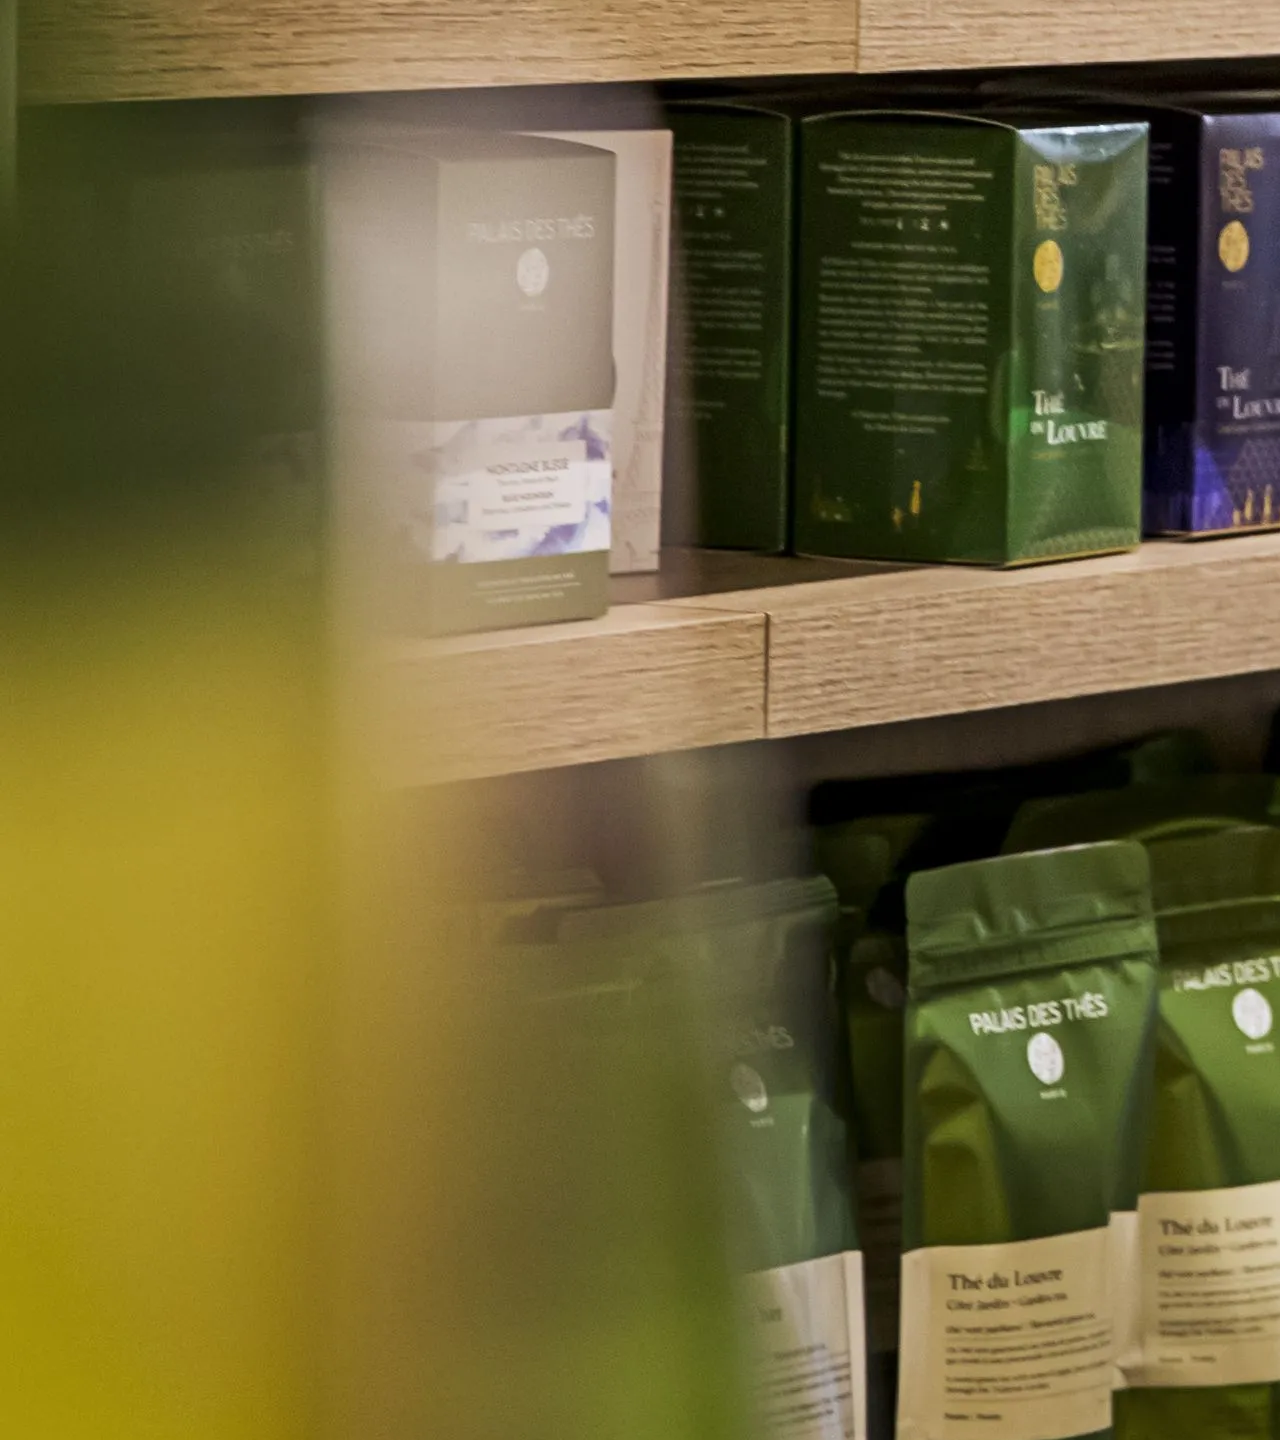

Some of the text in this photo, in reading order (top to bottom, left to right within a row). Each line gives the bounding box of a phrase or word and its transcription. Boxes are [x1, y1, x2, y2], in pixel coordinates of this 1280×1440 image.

[969, 1006, 1028, 1036] PALAIS
[1027, 1001, 1063, 1028] DES
[947, 1272, 984, 1291] Thé
[986, 1272, 1009, 1290] du
